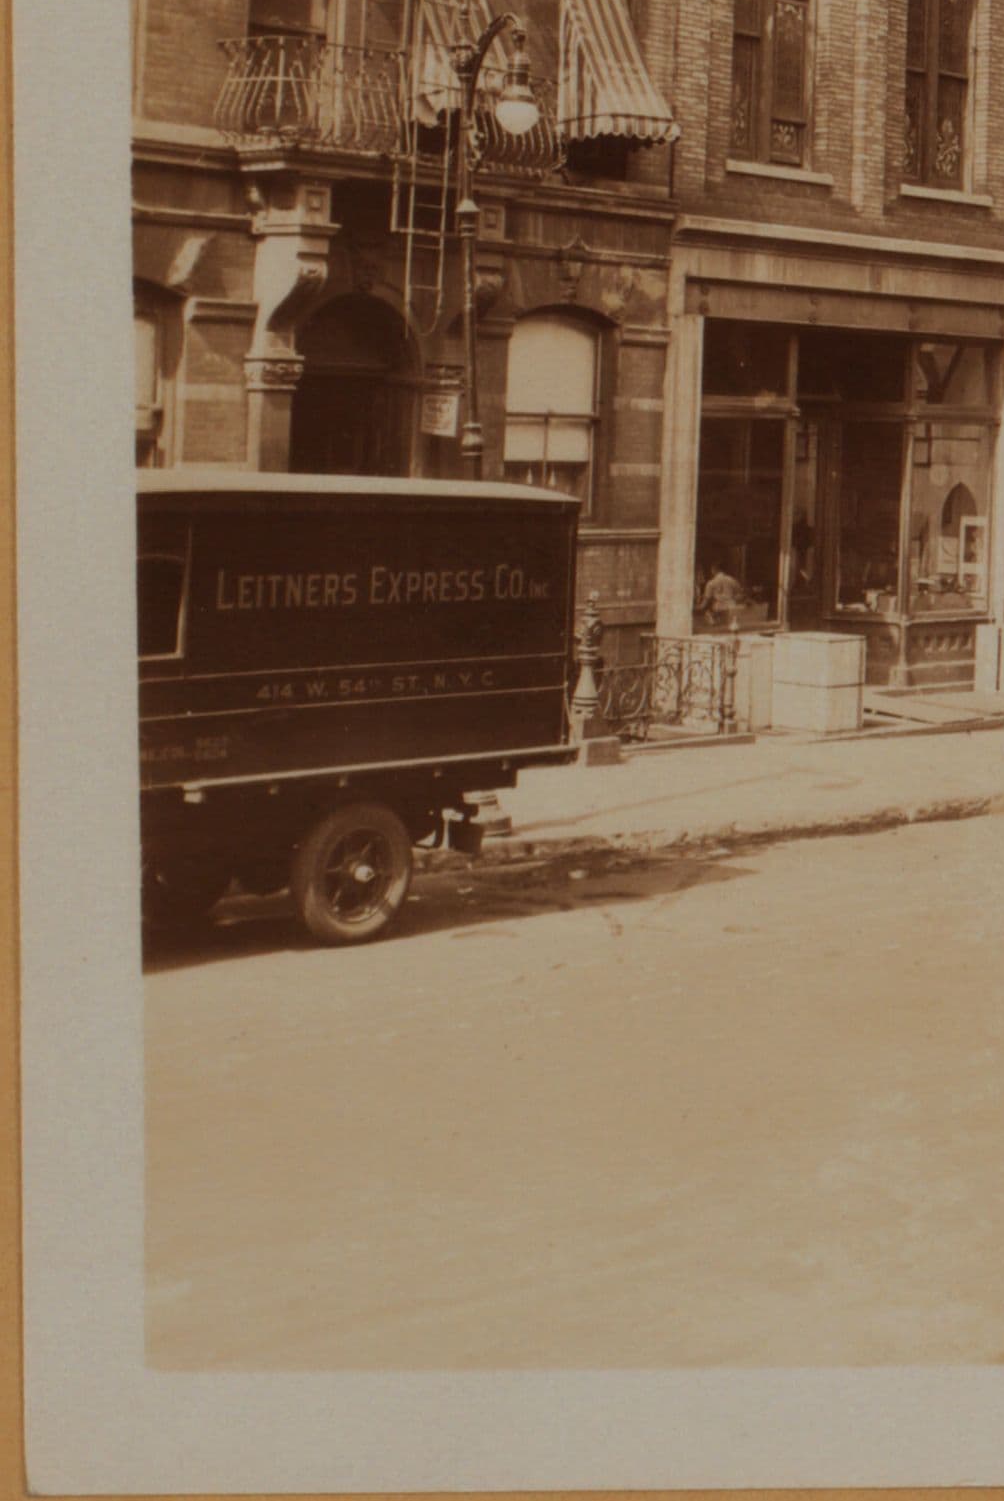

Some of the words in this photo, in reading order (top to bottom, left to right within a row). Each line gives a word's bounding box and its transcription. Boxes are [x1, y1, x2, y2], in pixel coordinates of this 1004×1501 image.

[215, 567, 358, 611] LEITNERS
[369, 565, 485, 604] EXPRESS
[256, 683, 294, 701] 414
